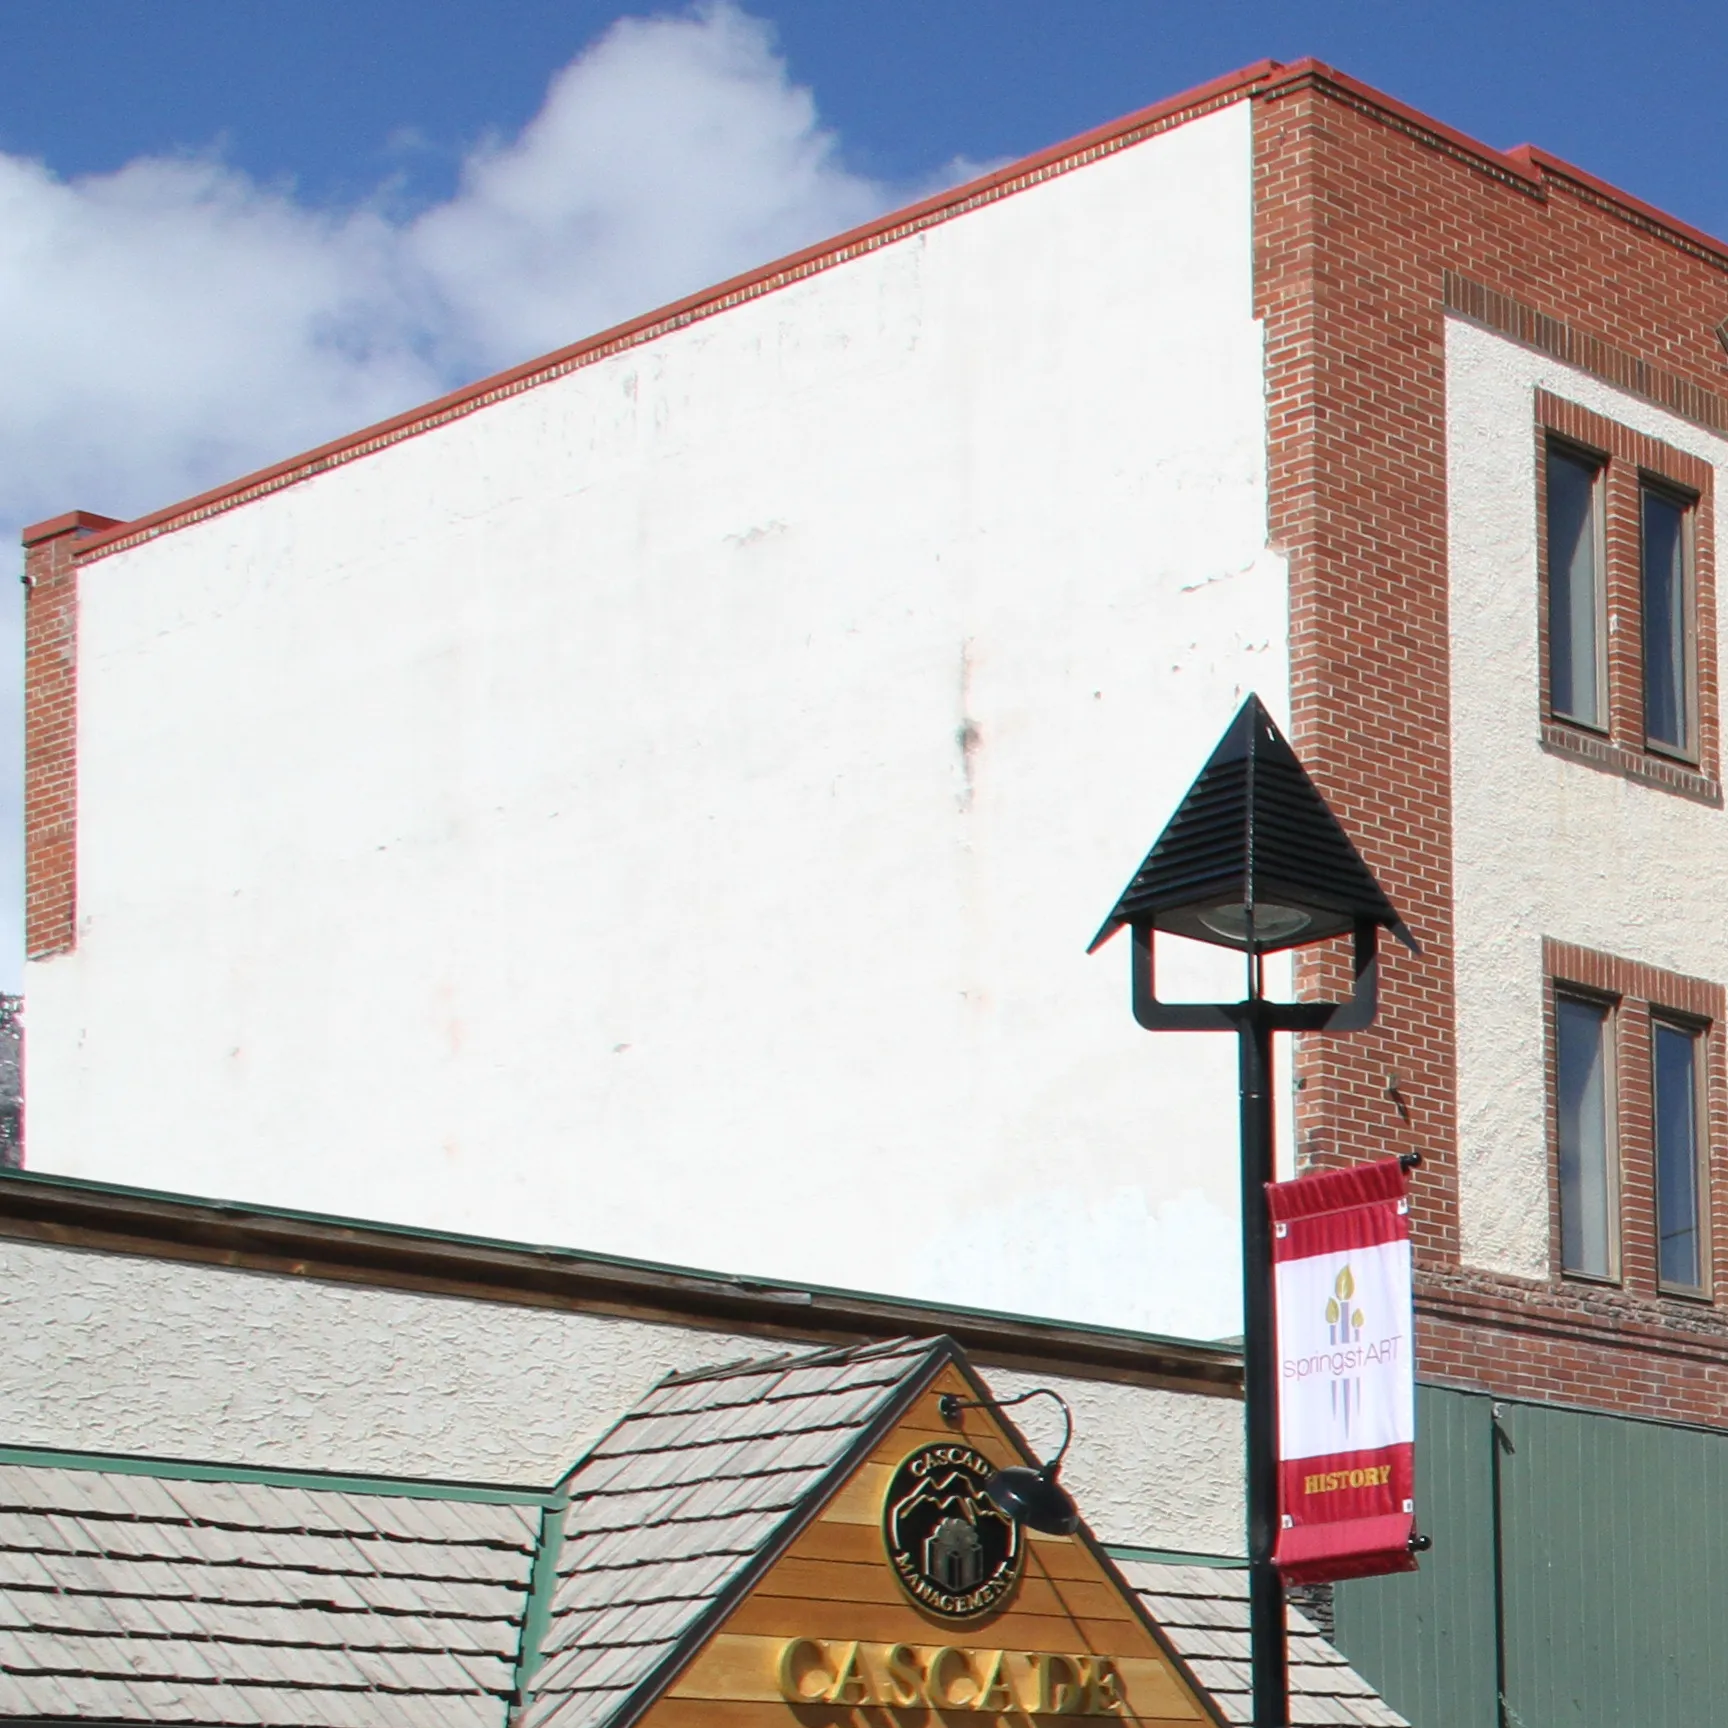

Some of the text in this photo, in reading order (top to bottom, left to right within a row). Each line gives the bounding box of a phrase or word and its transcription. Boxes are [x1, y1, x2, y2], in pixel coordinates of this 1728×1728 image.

[1283, 1335, 1402, 1381] springstART
[1304, 1464, 1391, 1494] HISTORY
[895, 1551, 1015, 1612] MANAGEMENT
[777, 1635, 1126, 1713] CASCADE
